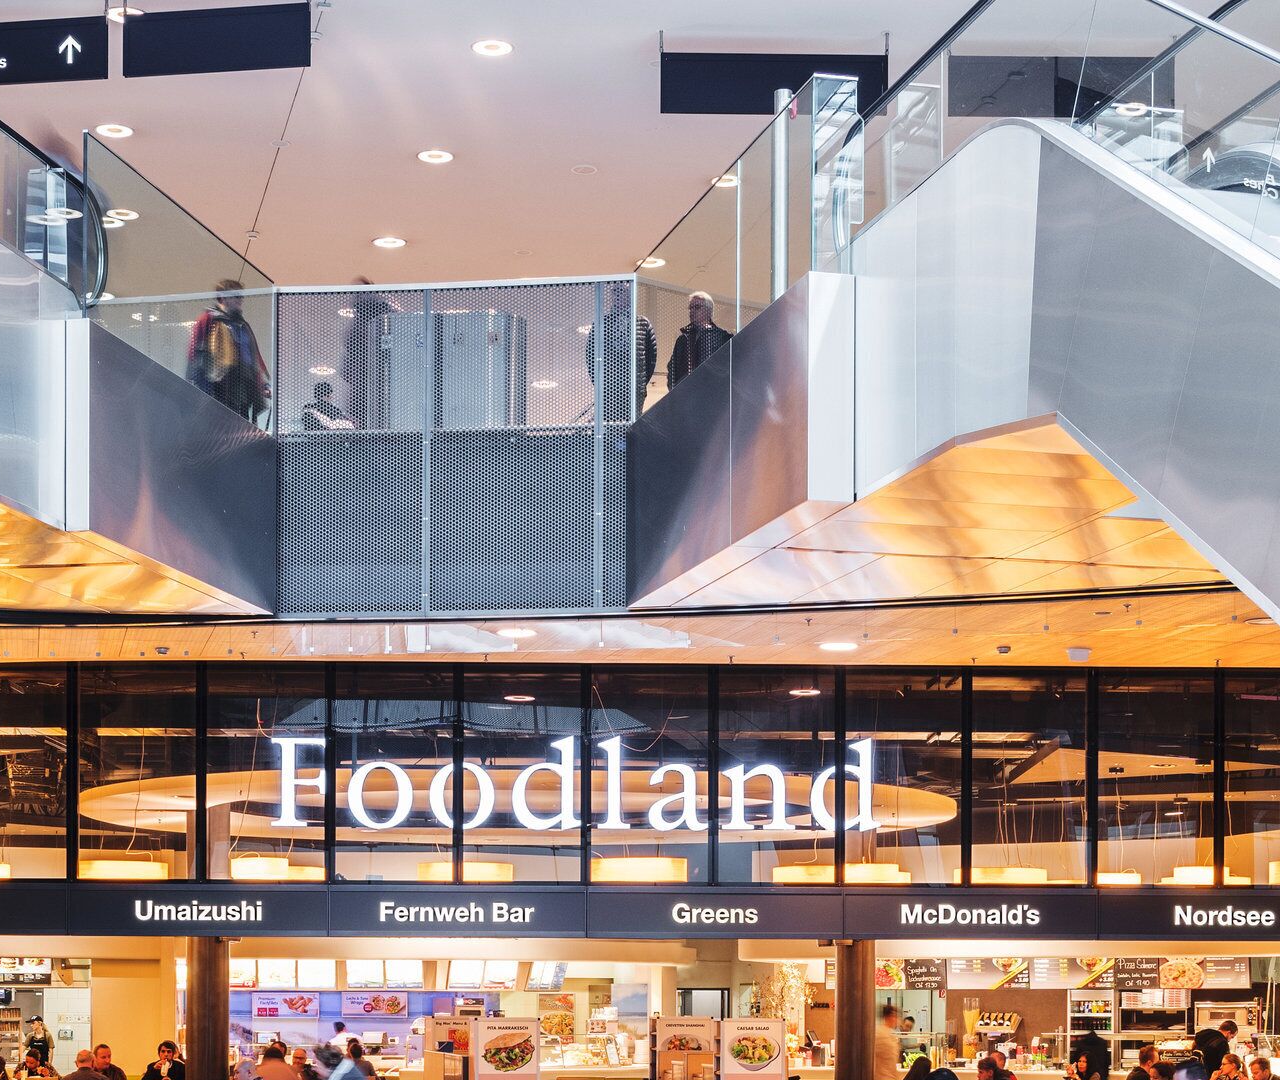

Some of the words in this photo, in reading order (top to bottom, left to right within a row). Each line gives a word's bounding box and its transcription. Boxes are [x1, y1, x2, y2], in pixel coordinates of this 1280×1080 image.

[270, 734, 882, 832] Foodland
[134, 900, 263, 922] Umaizushi
[379, 901, 485, 923] Fernweh
[491, 902, 536, 923] Bar
[671, 902, 760, 924] Greens
[900, 903, 1041, 926] McDonald's
[1174, 905, 1276, 927] Nordsee
